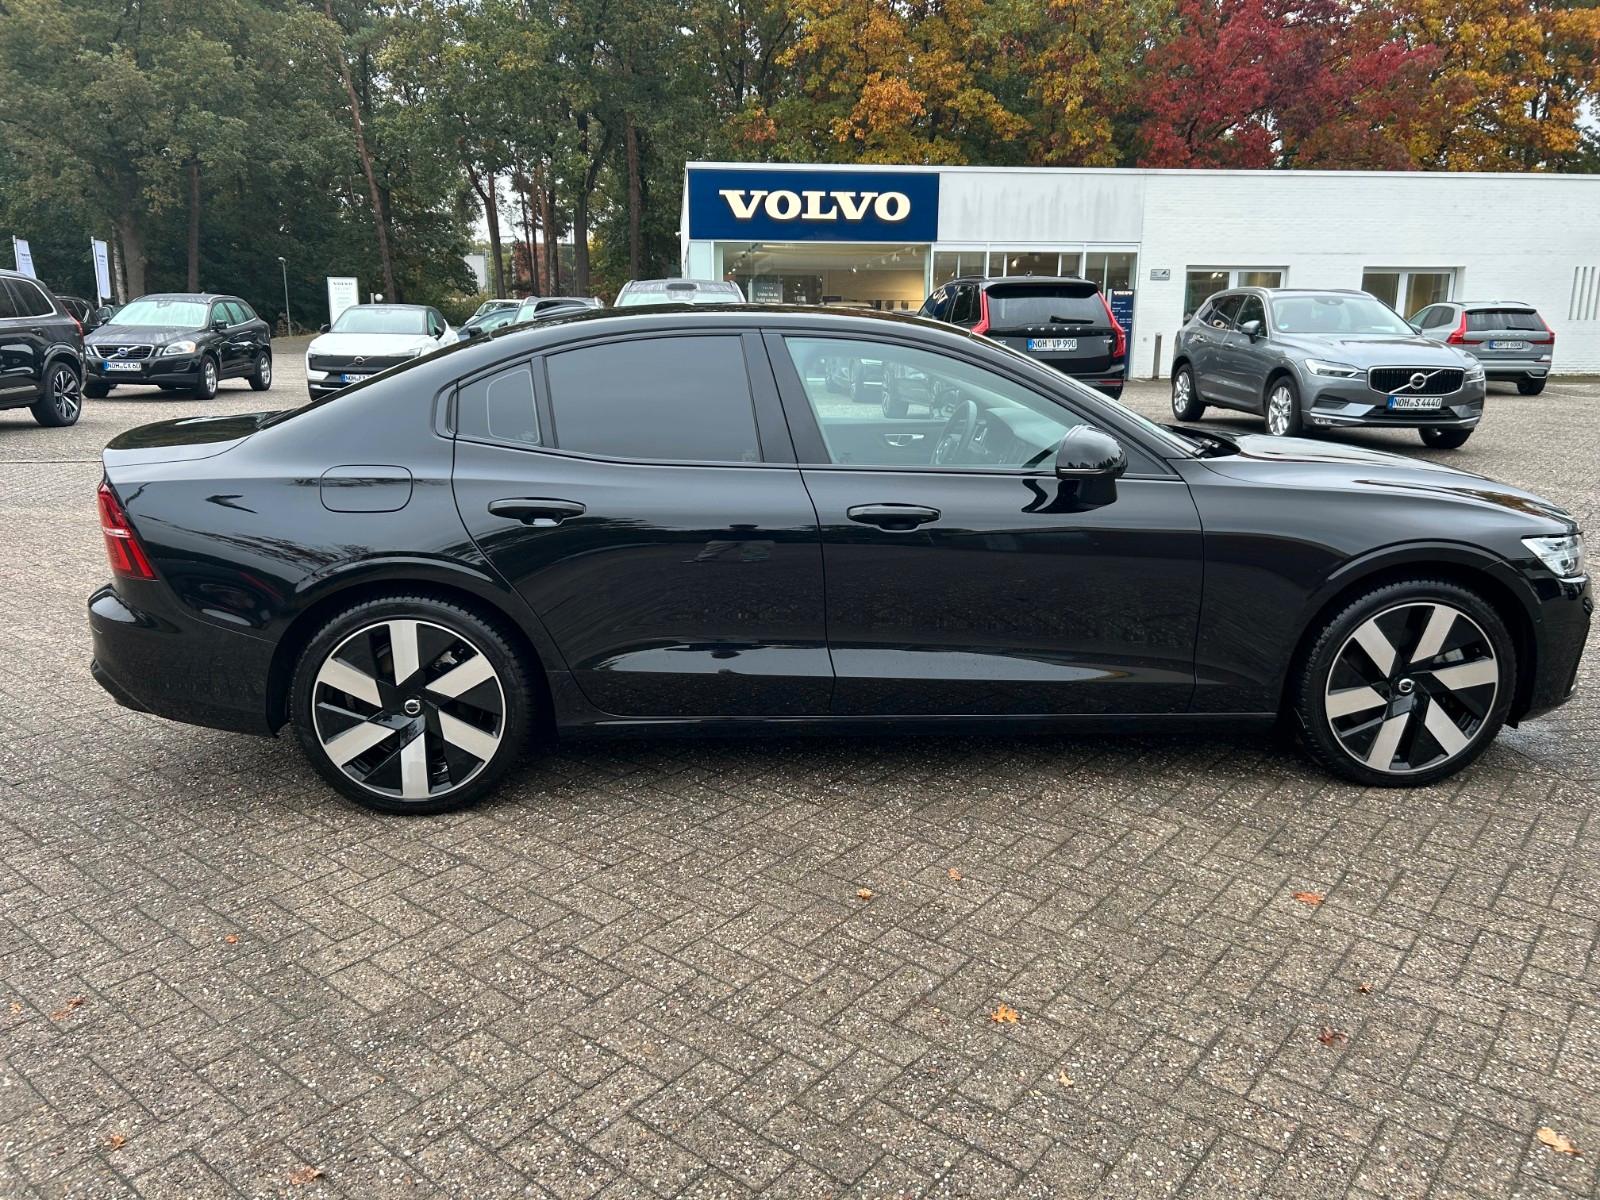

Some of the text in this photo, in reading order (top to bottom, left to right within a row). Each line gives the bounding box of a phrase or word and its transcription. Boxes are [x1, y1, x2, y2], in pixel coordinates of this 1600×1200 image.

[719, 189, 910, 221] VOLVO
[1032, 339, 1076, 349] NOH VP 990
[1393, 398, 1410, 408] NOH
[1421, 398, 1441, 407] 4440
